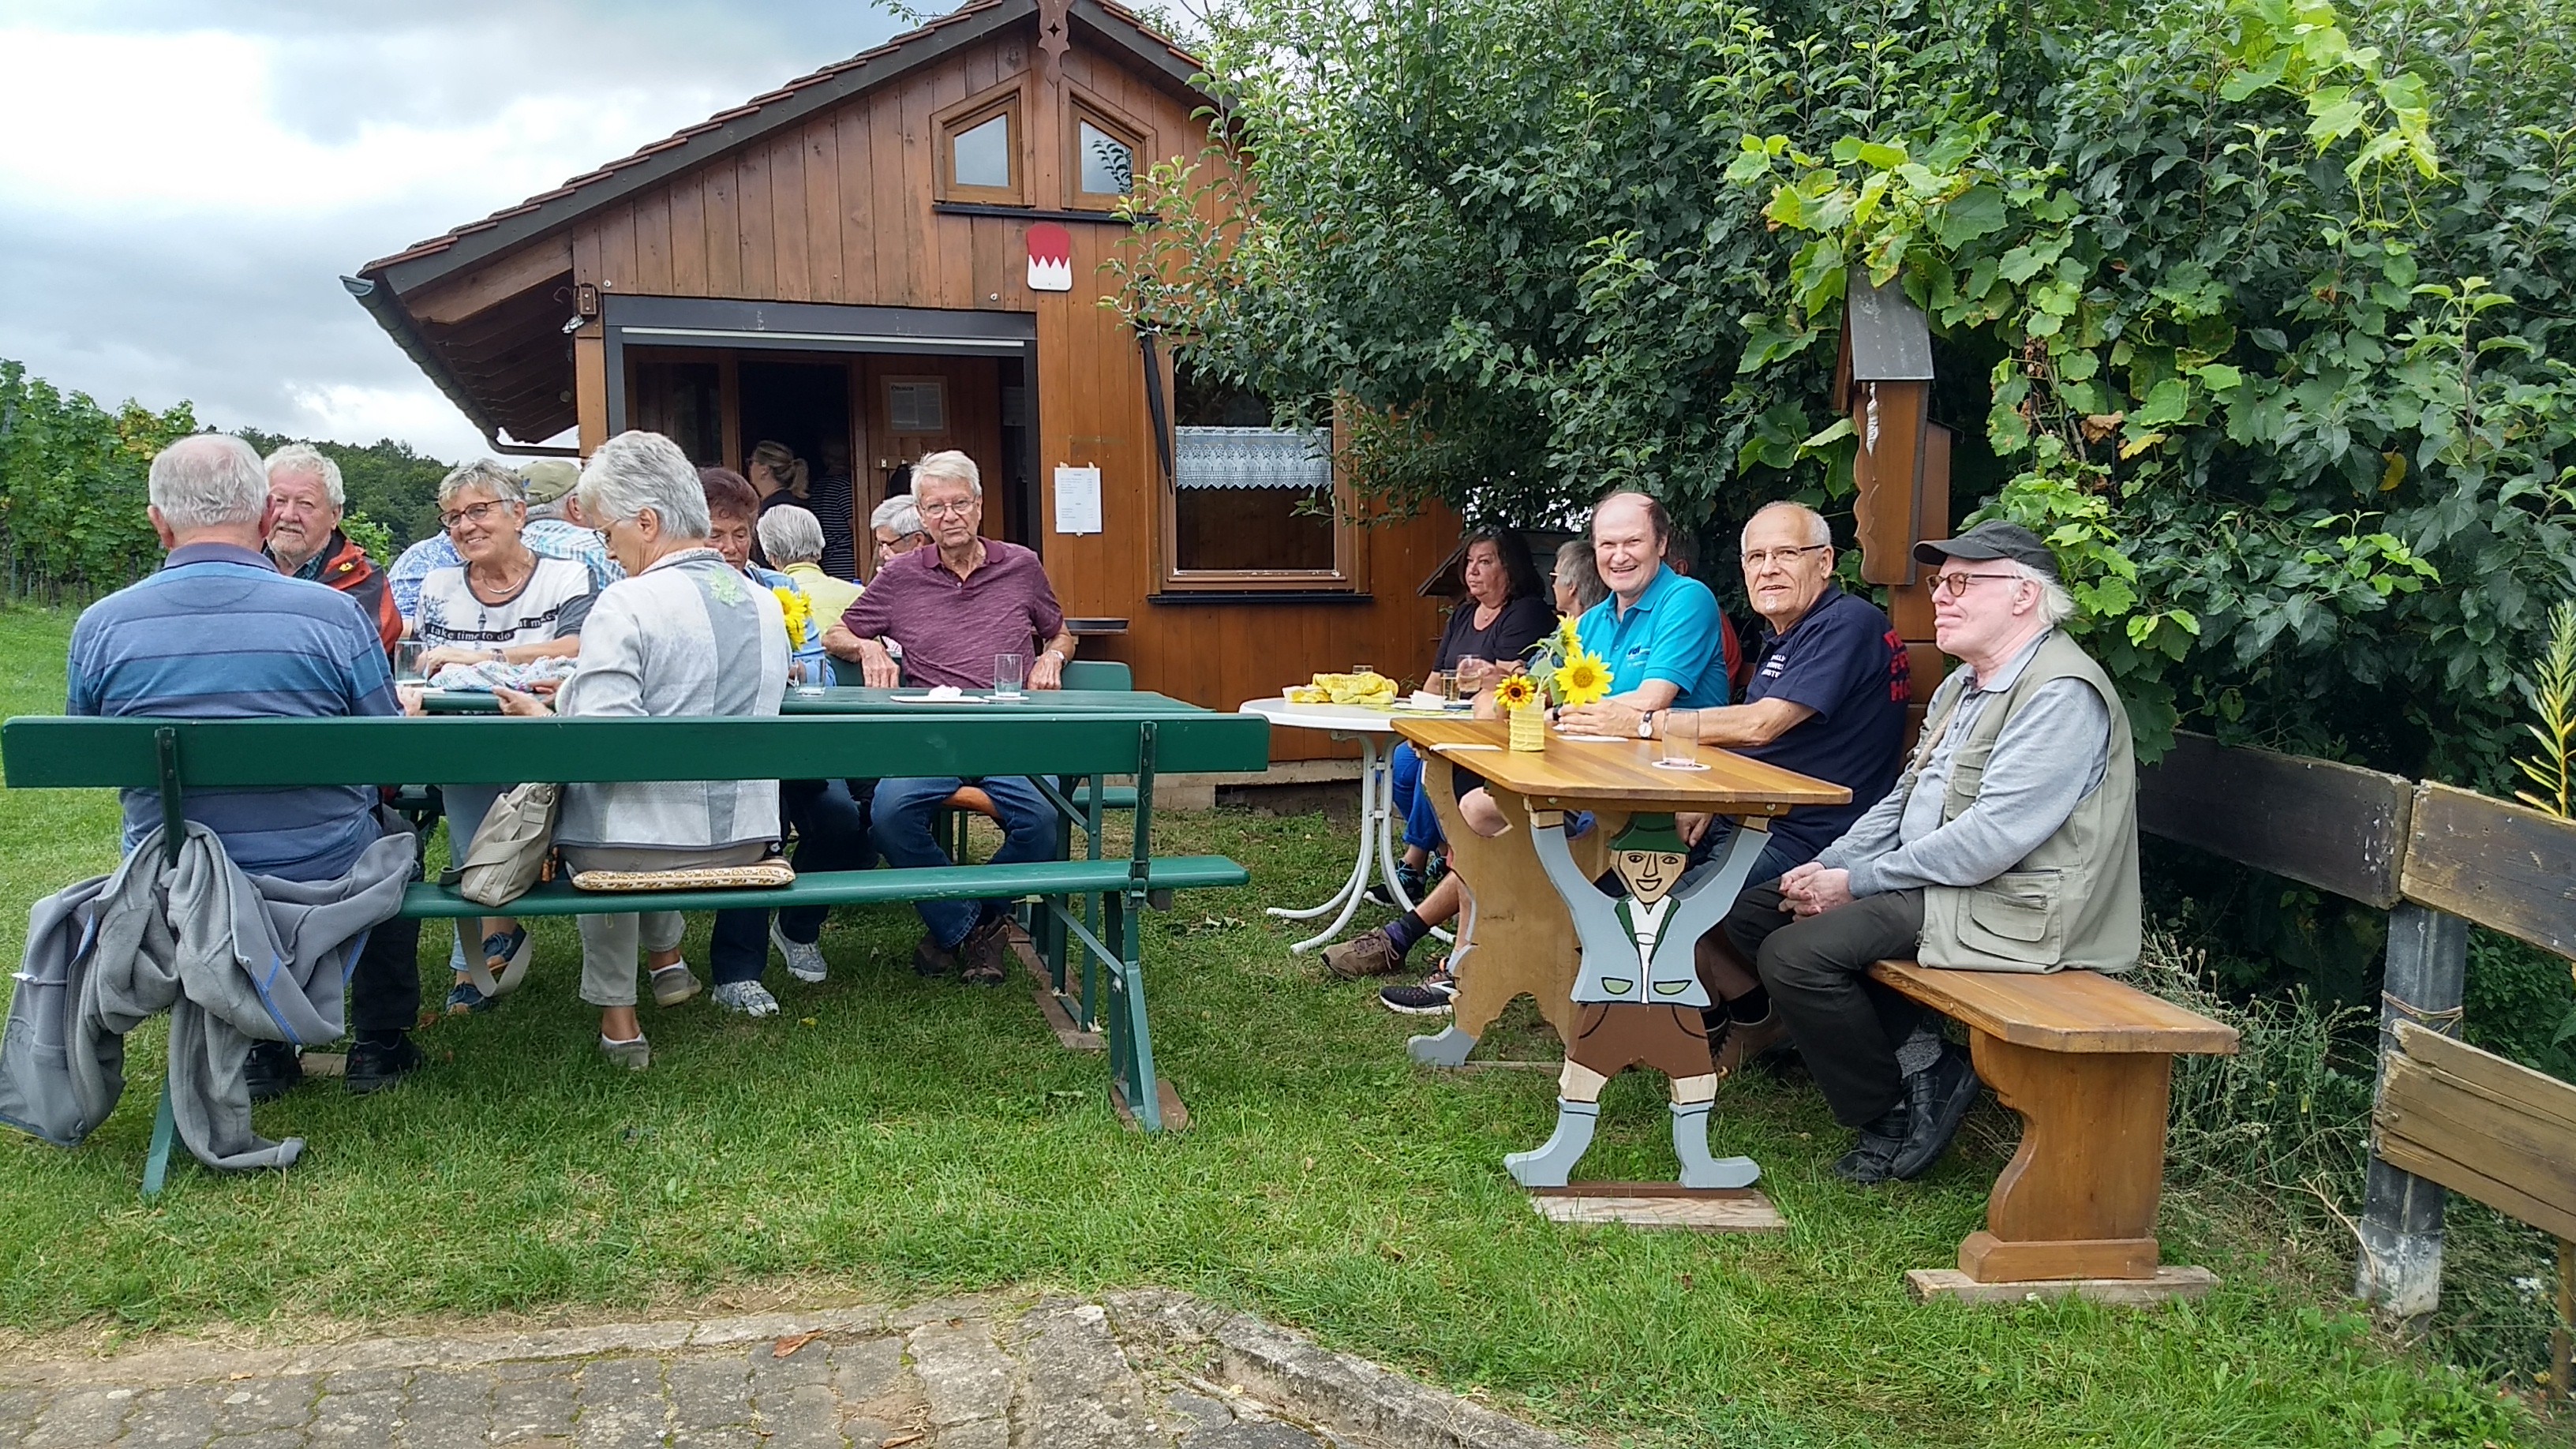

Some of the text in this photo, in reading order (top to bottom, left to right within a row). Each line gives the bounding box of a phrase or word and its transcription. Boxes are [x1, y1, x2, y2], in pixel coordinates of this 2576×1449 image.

[430, 625, 454, 639] take
[481, 631, 493, 641] to
[497, 631, 511, 641] do
